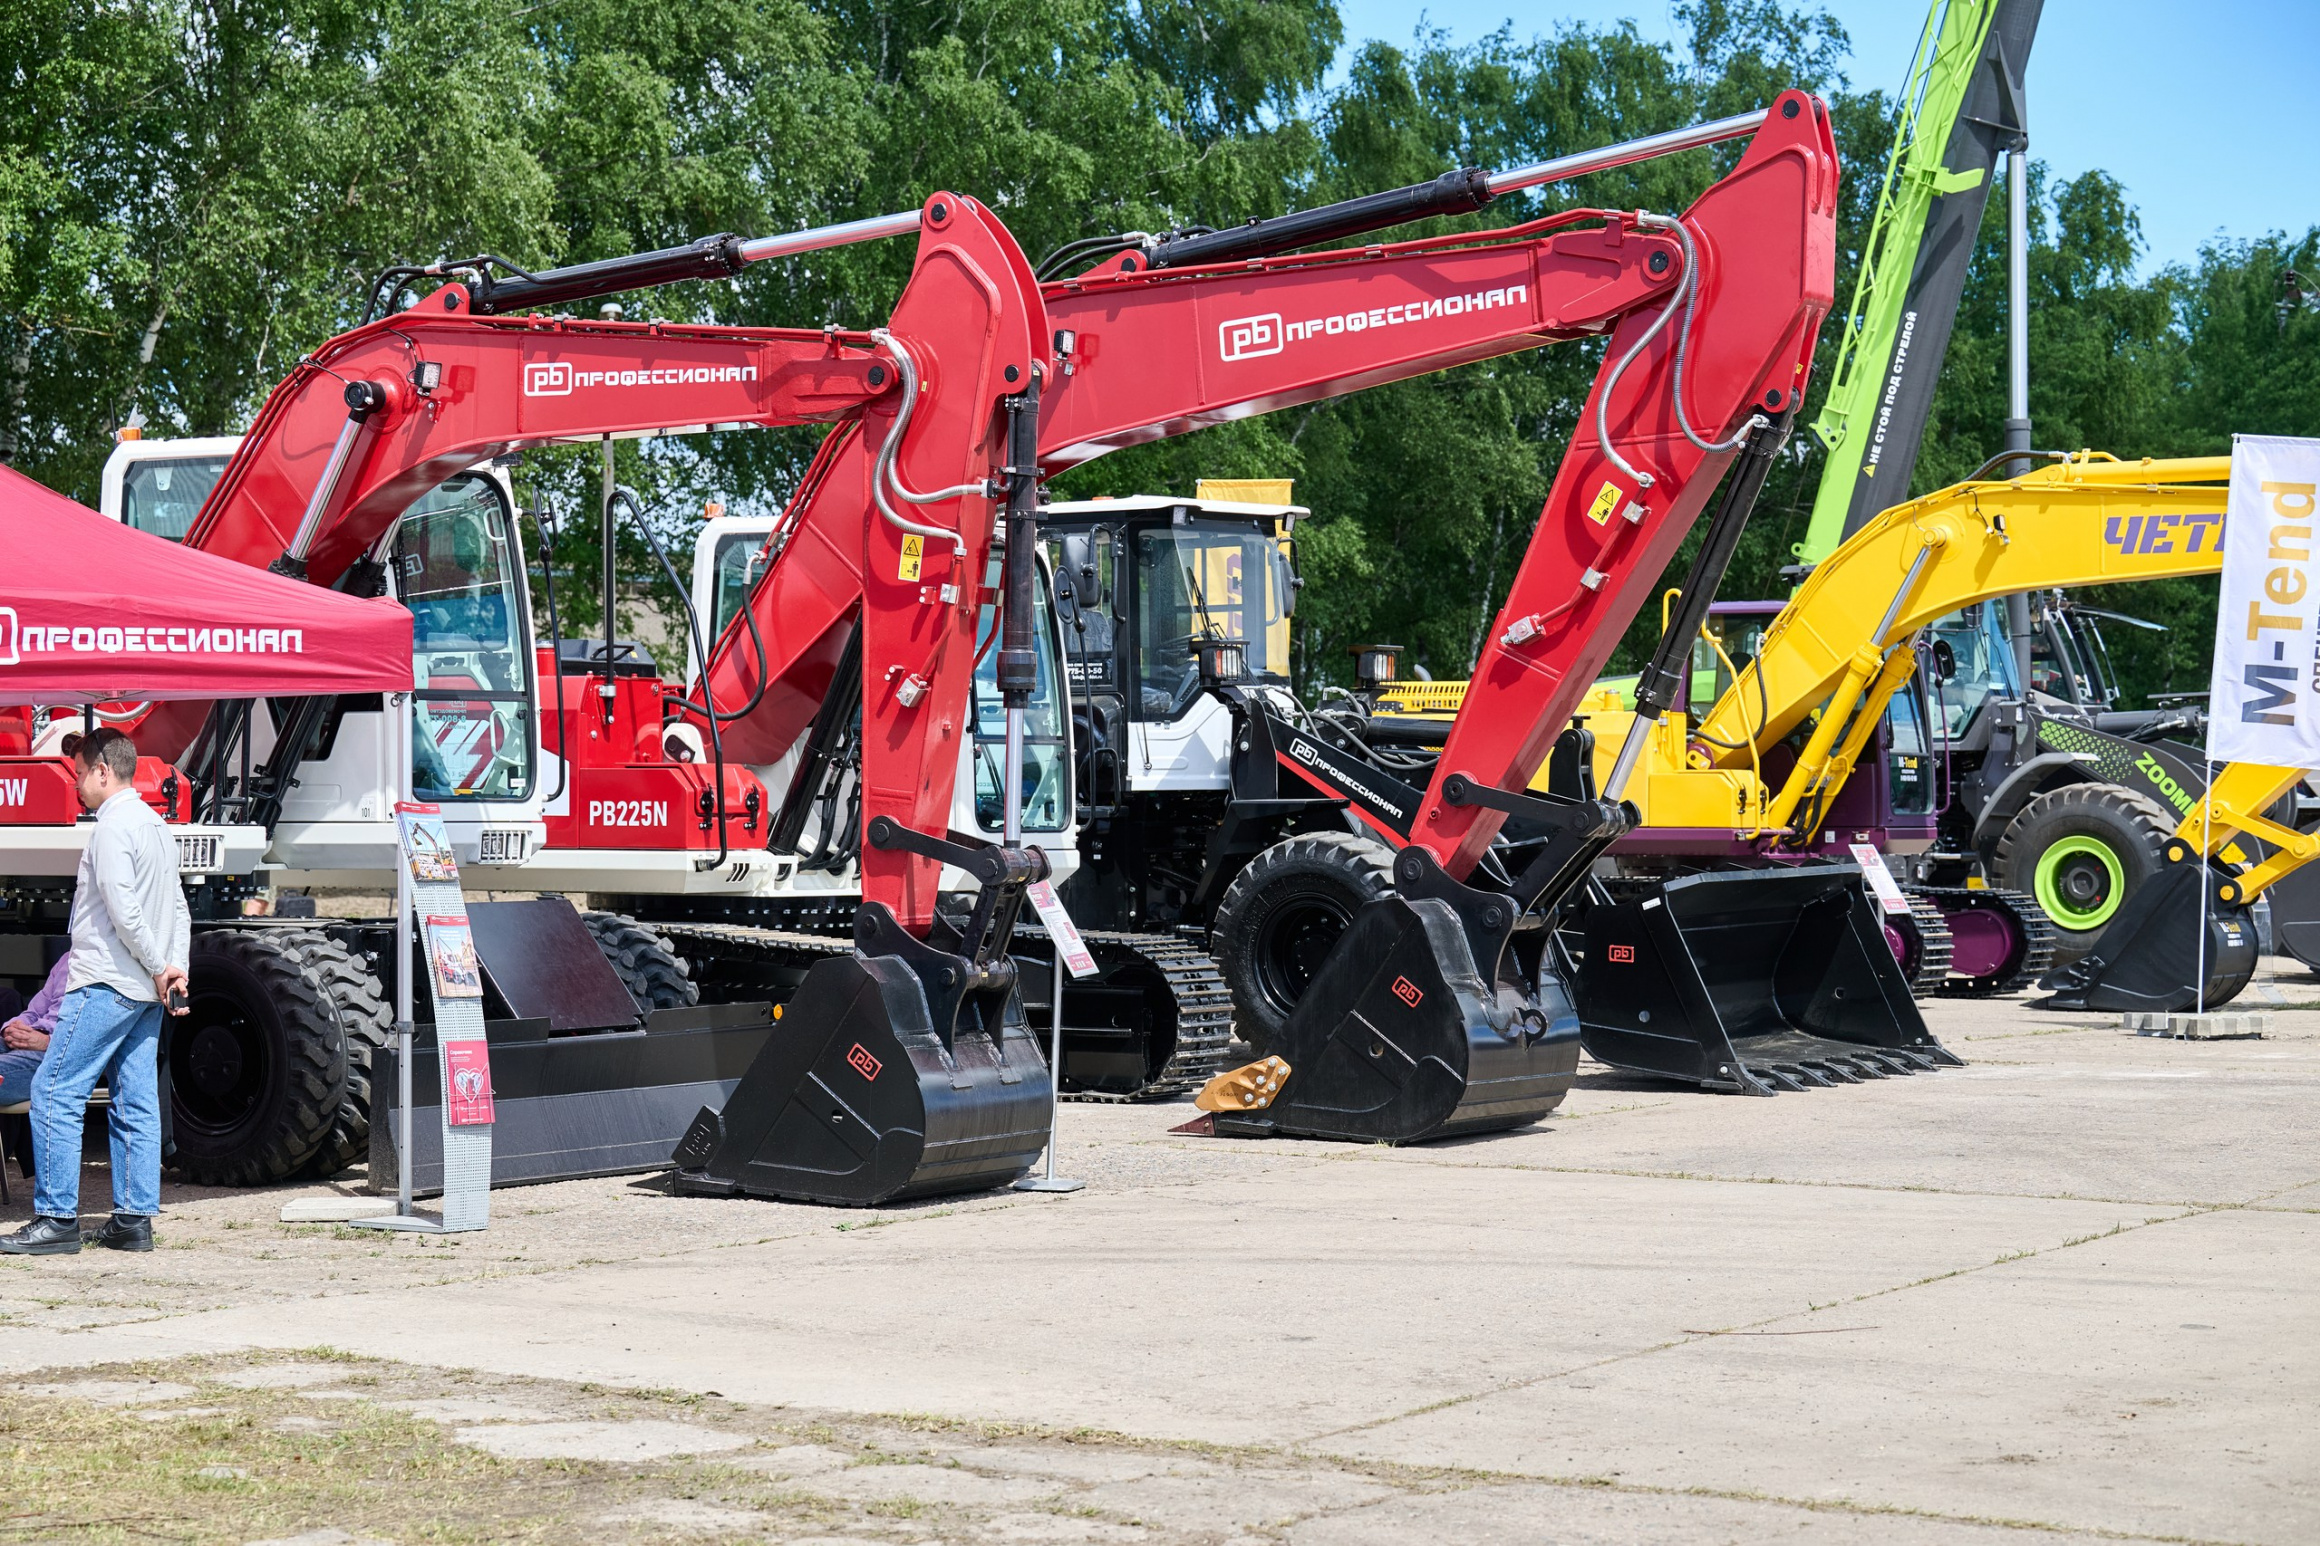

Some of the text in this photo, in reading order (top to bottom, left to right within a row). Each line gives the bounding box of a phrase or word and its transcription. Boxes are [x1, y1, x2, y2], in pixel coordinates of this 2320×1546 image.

[1285, 285, 1527, 342] ПРОФЕССИОНАЛ
[575, 366, 757, 387] ПРОФЕССИОНАЛ
[1869, 311, 1917, 463] НЕ СТОЙ ПОД СТРЕЛОЙ
[2241, 481, 2316, 726] M-Tend
[22, 627, 303, 653] ПРОФЕССИОНАЛ
[589, 800, 667, 827] PB225N
[1315, 758, 1403, 818] ПРОФЕССИОНАЛ
